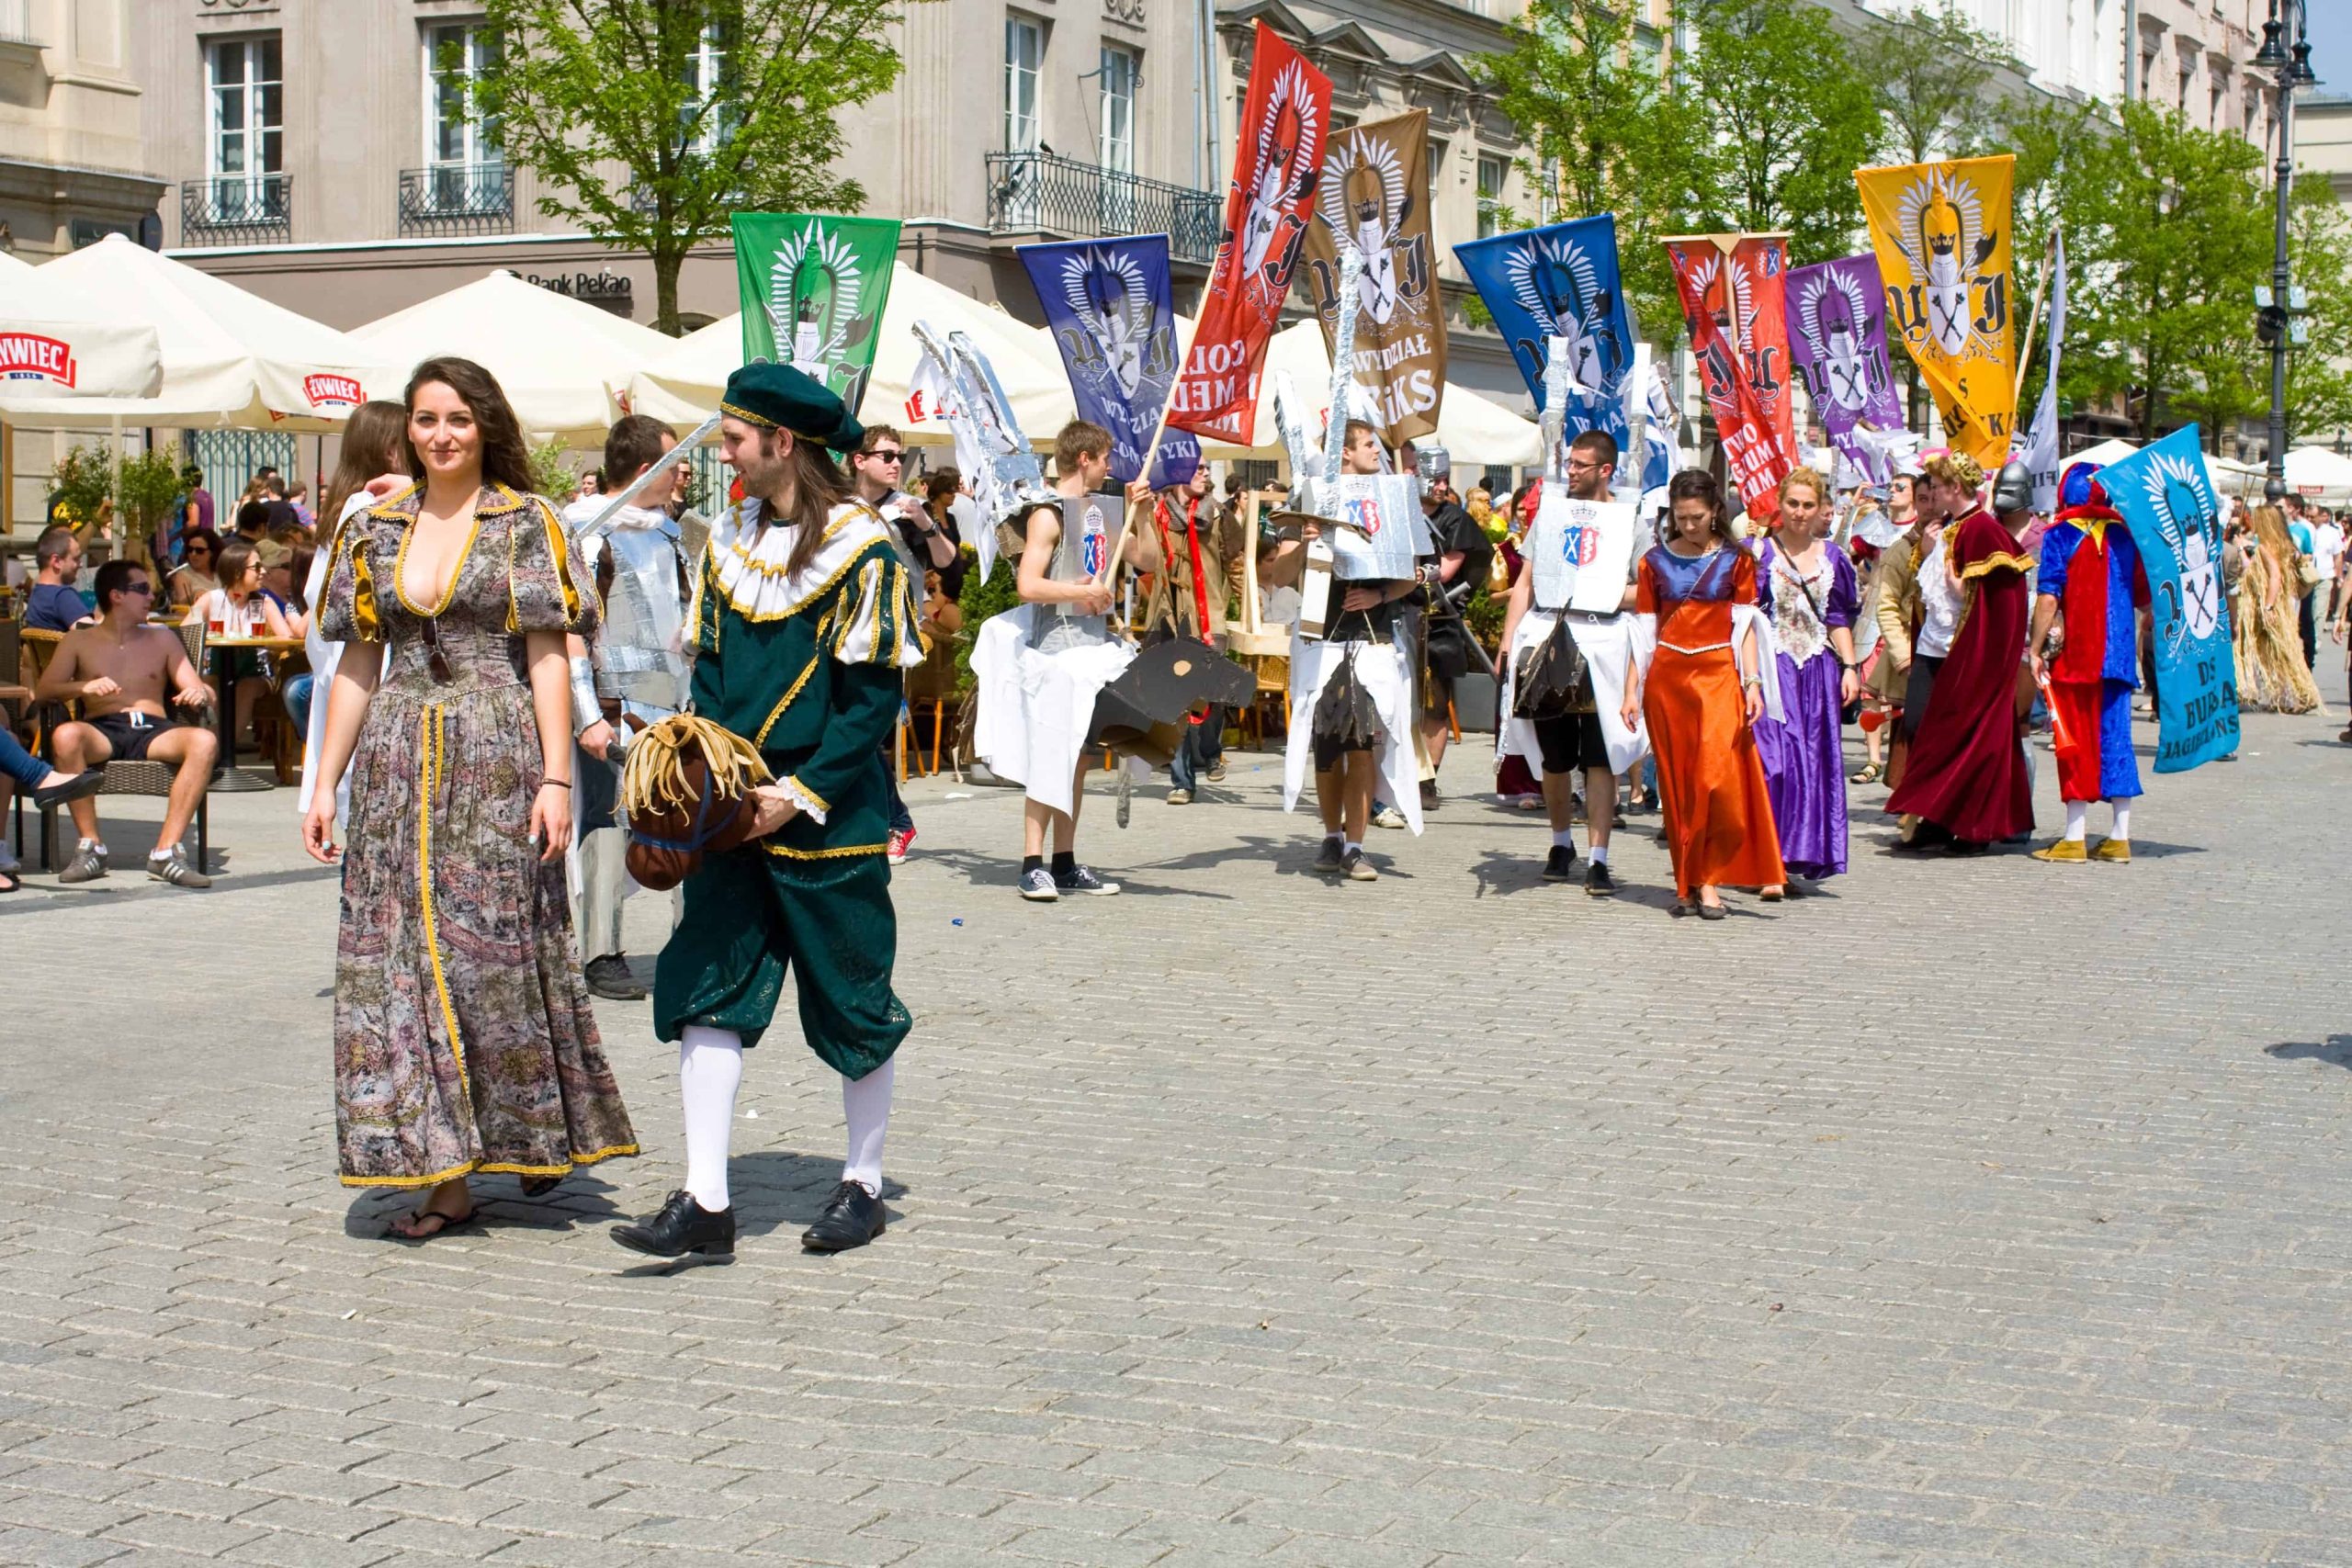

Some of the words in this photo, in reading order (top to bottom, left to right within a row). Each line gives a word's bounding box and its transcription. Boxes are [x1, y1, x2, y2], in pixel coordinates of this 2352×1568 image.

[527, 274, 572, 294] Bank
[576, 273, 631, 294] Pekao
[0, 338, 63, 372] YWIEC
[1352, 333, 1431, 372] WYDZIAŁ
[309, 376, 358, 400] ŻYWIEC
[1100, 396, 1165, 434] WYZIA
[2184, 681, 2236, 729] BURA
